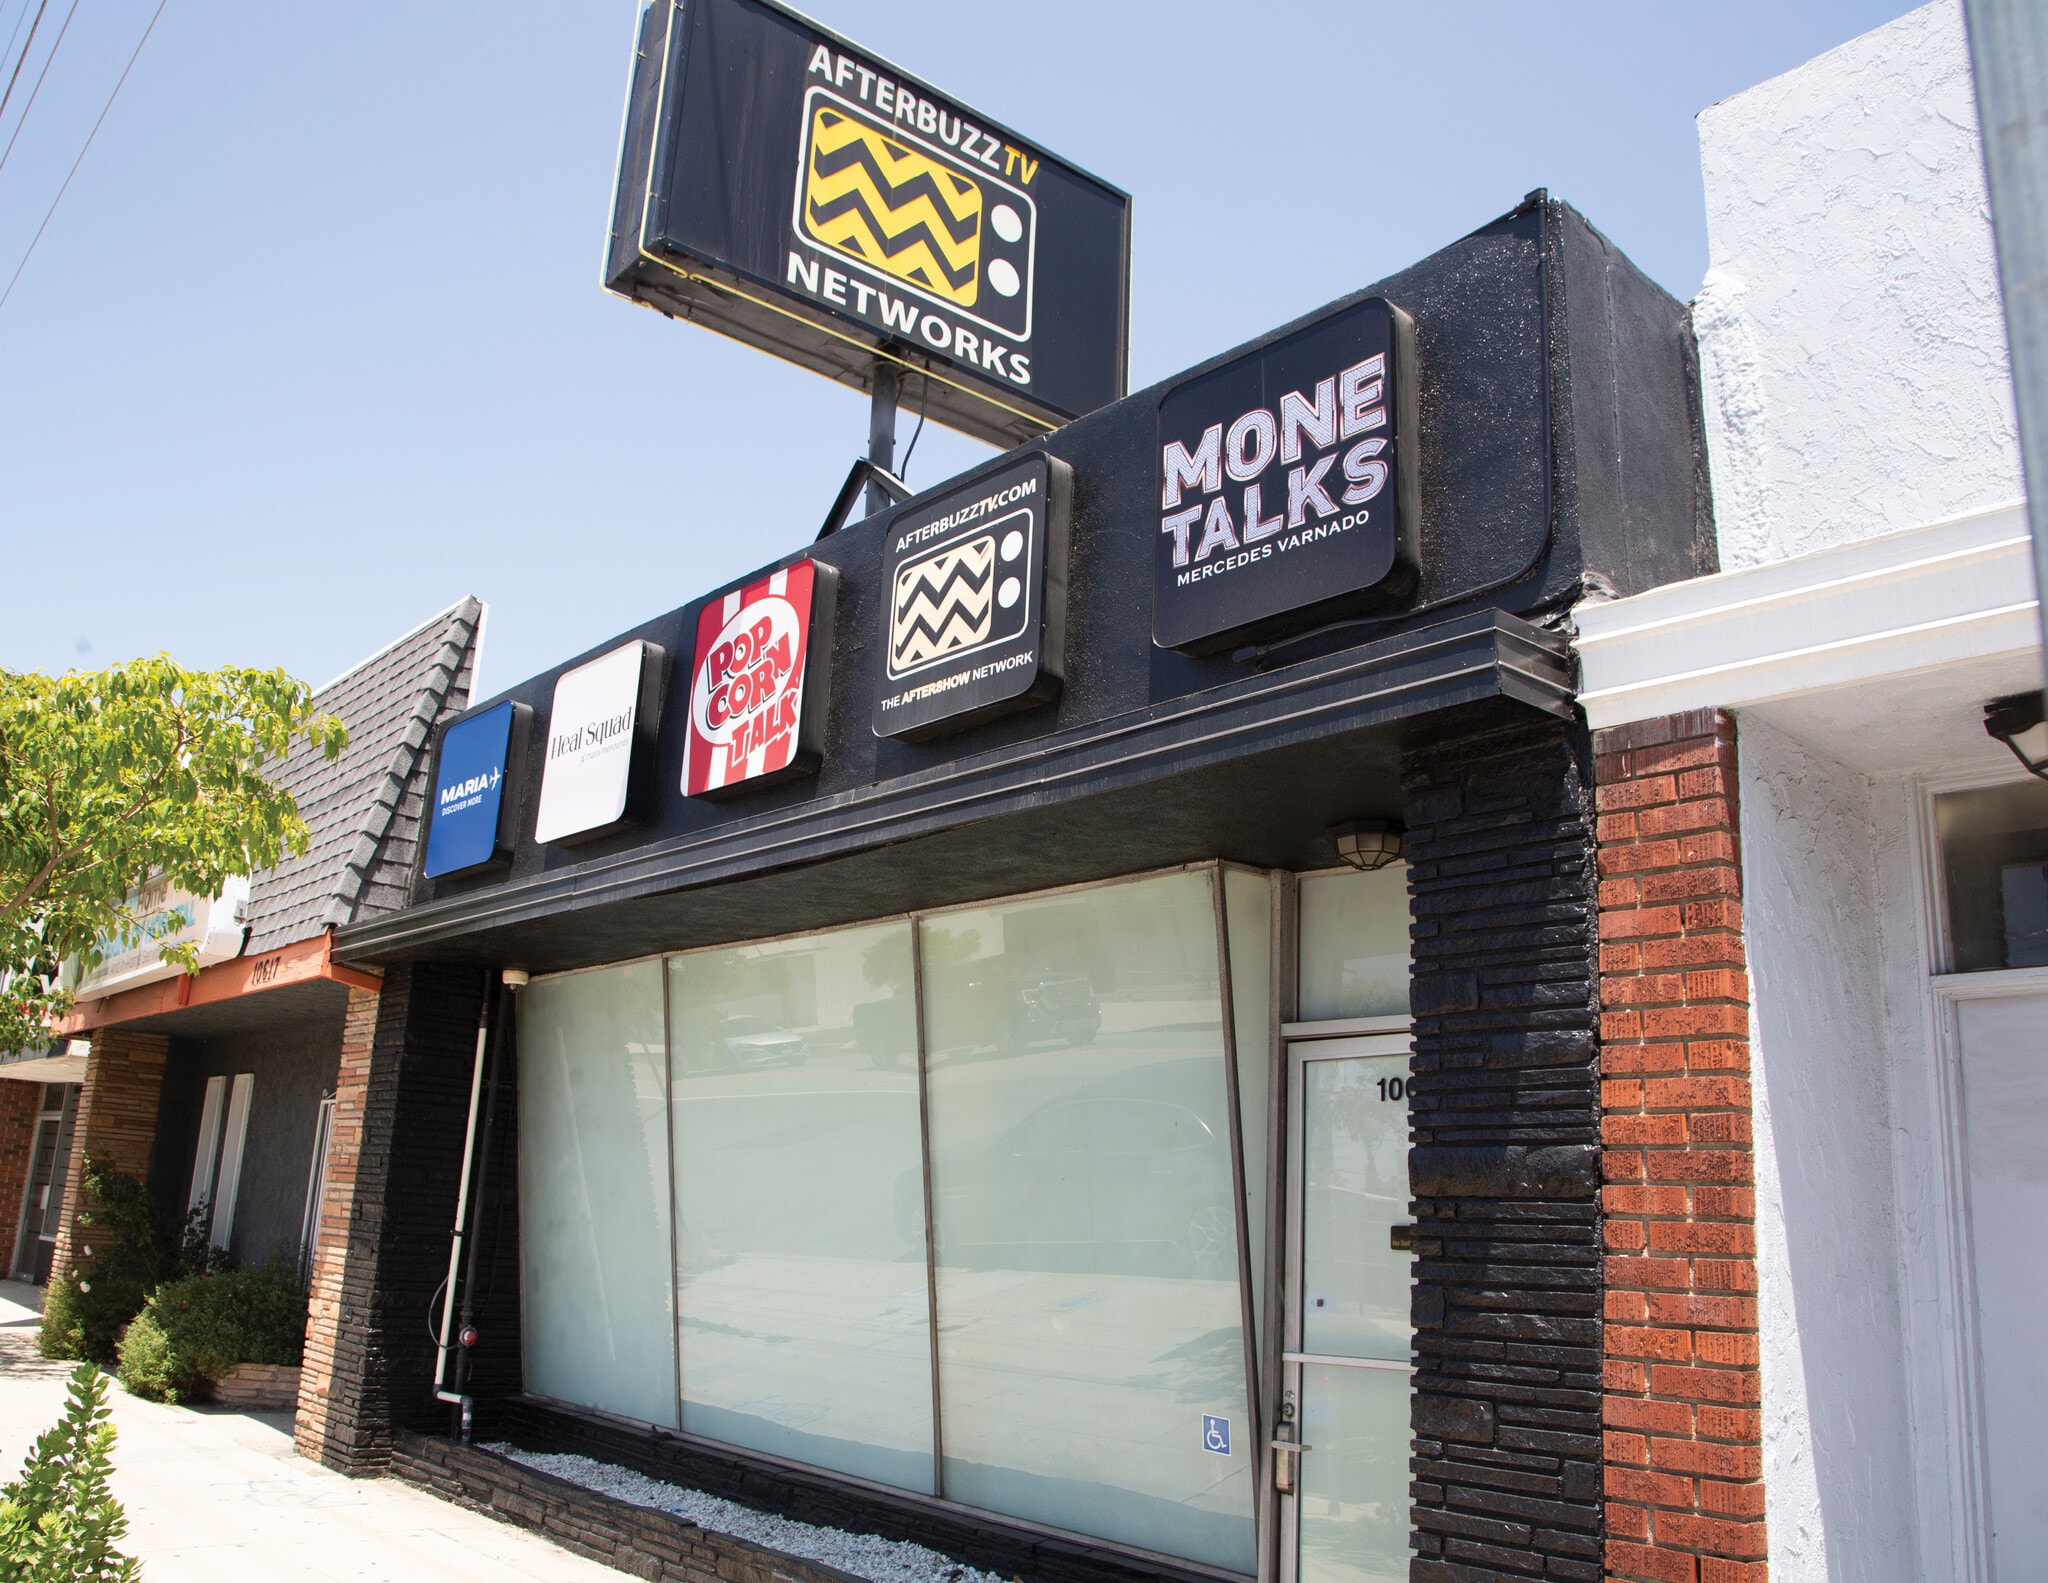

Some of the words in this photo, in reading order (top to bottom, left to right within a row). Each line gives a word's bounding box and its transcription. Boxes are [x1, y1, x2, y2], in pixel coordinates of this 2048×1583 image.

[786, 251, 1032, 386] NETWORKS
[1162, 352, 1387, 511] MONE
[895, 477, 1037, 553] AFTERBUZZTV.COM
[1161, 437, 1389, 569] TALKS
[1177, 544, 1273, 588] MERCEDES
[1277, 510, 1370, 552] VARNADO
[706, 615, 773, 694] POP
[706, 631, 792, 731] CORN
[881, 694, 901, 711] THE
[901, 670, 971, 705] AFTERSHOW
[972, 651, 1033, 682] NETWORK
[551, 727, 583, 759] Heal
[585, 706, 632, 745] Squad
[731, 690, 798, 768] TALK
[440, 773, 489, 805] MARIA
[442, 800, 467, 816] DISCOVER
[467, 794, 482, 807] MORE
